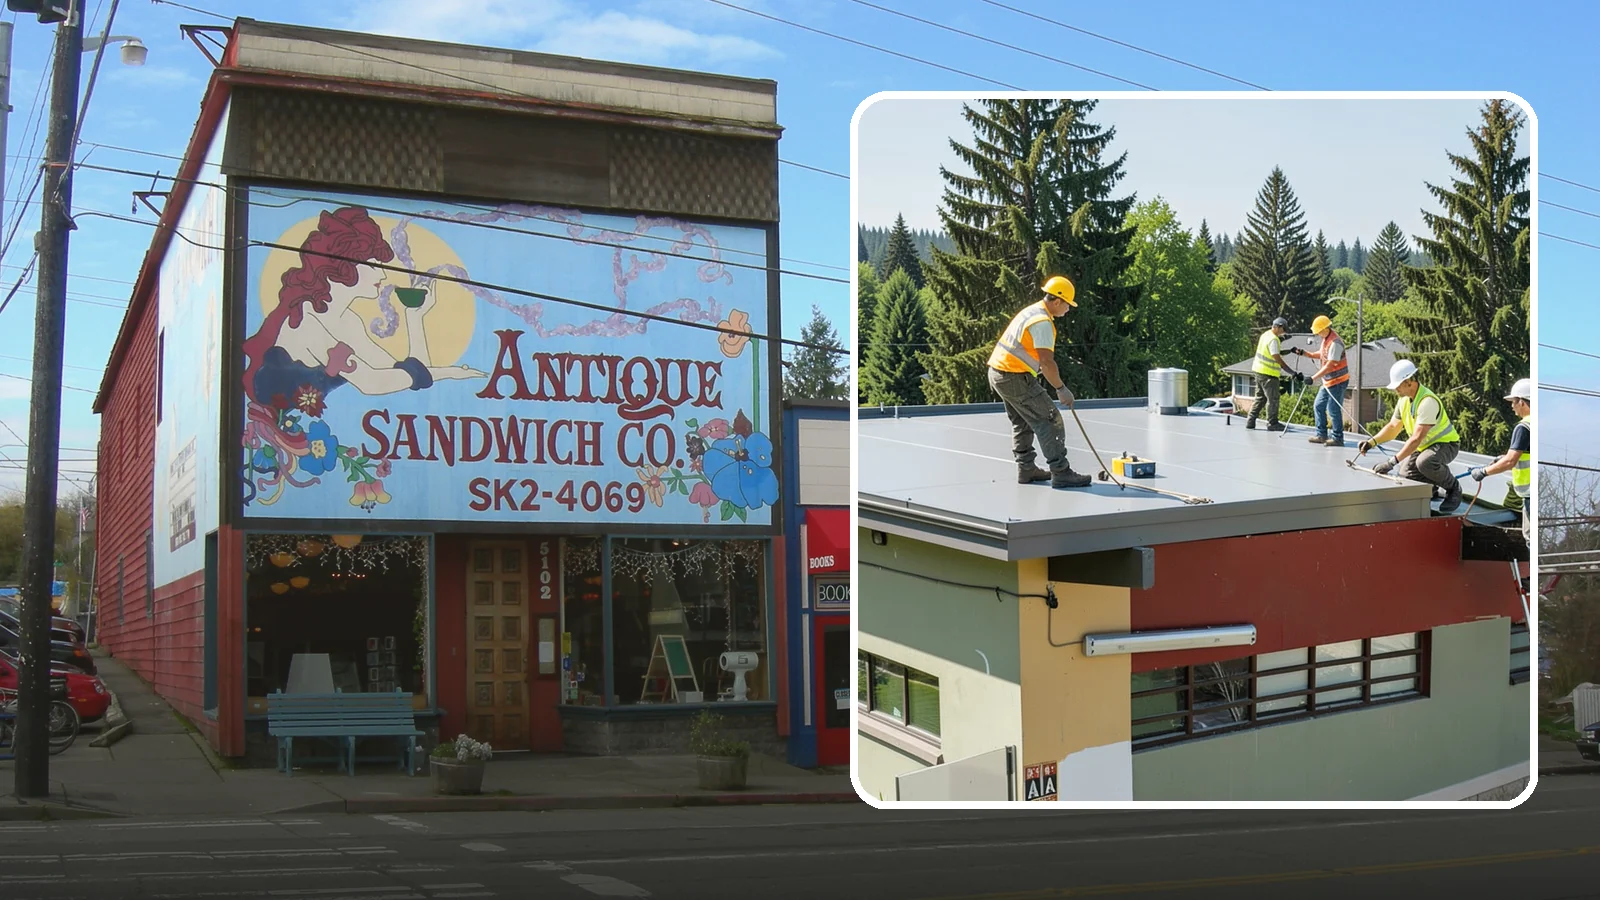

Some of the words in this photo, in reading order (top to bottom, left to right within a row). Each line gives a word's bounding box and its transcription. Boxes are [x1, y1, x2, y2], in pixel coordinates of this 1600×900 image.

[476, 329, 723, 420] ANTIQUE
[361, 408, 604, 467] SANDWICH
[617, 422, 685, 468] CO.
[468, 477, 646, 513] SK2-4069
[540, 542, 552, 600] 5102
[809, 555, 834, 569] BOOKS
